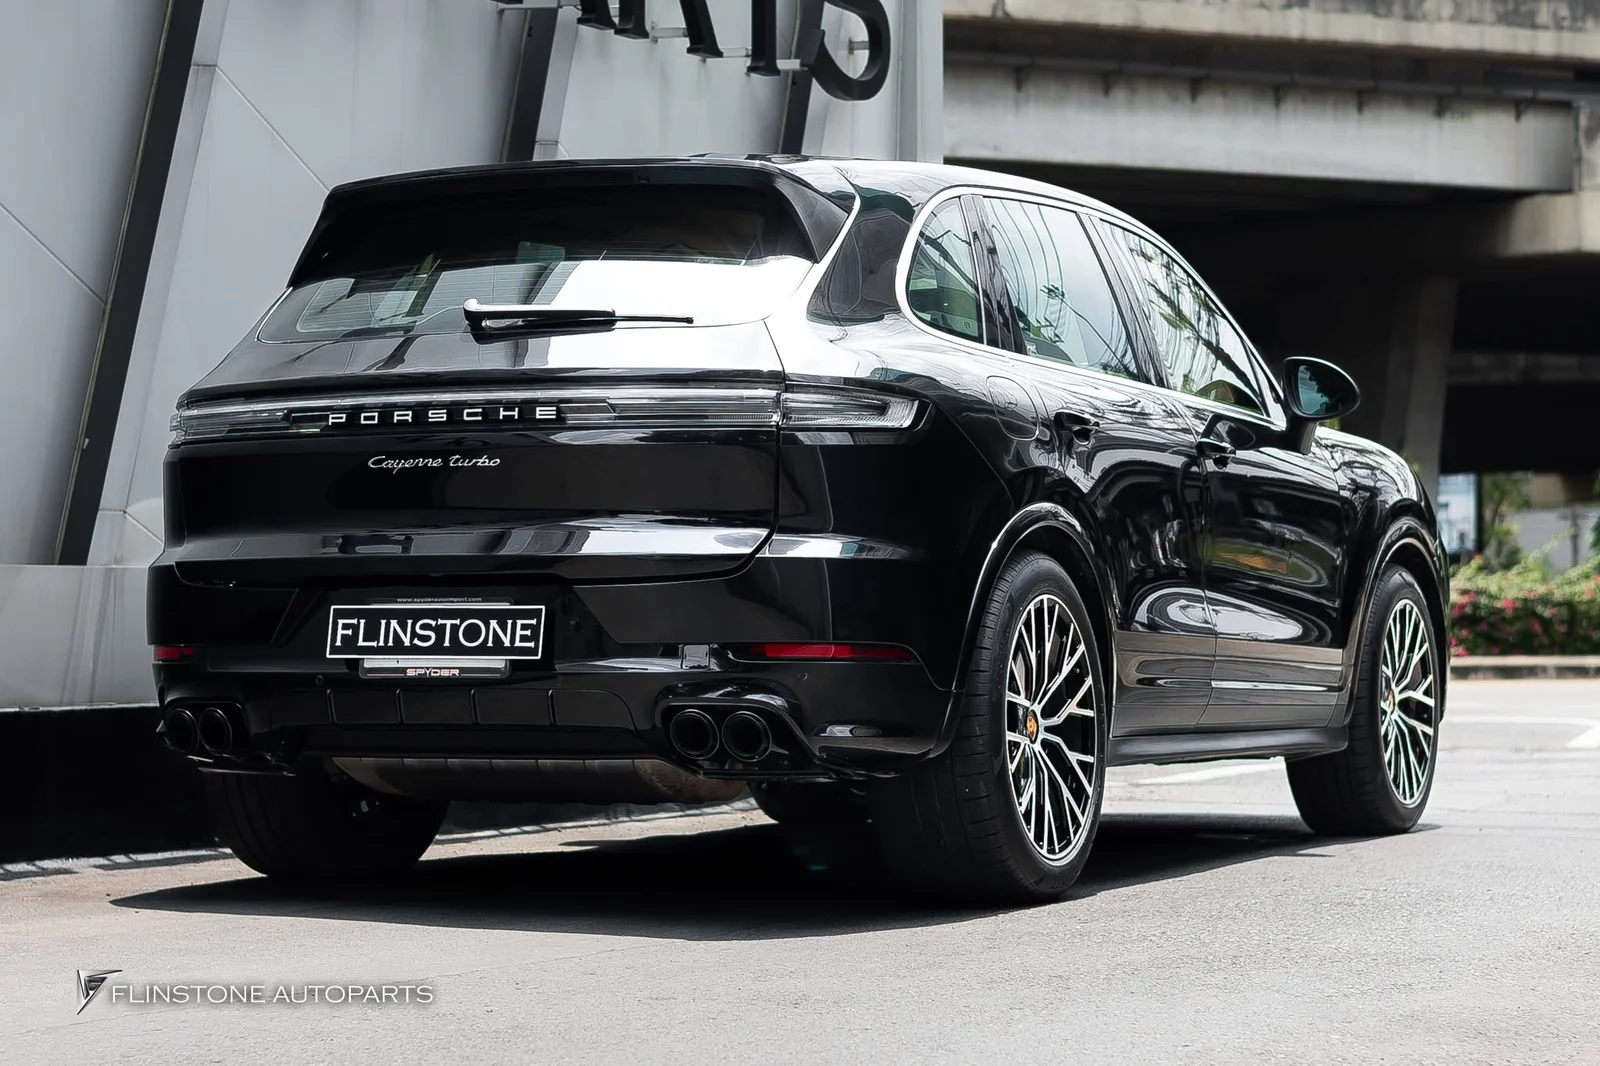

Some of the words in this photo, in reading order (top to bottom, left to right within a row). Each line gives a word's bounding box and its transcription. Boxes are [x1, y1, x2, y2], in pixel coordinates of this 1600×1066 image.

[328, 406, 557, 426] PORSCHE
[367, 455, 443, 474] Cayenne
[335, 617, 537, 648] FLINSTONE
[405, 668, 460, 678] SPYDER
